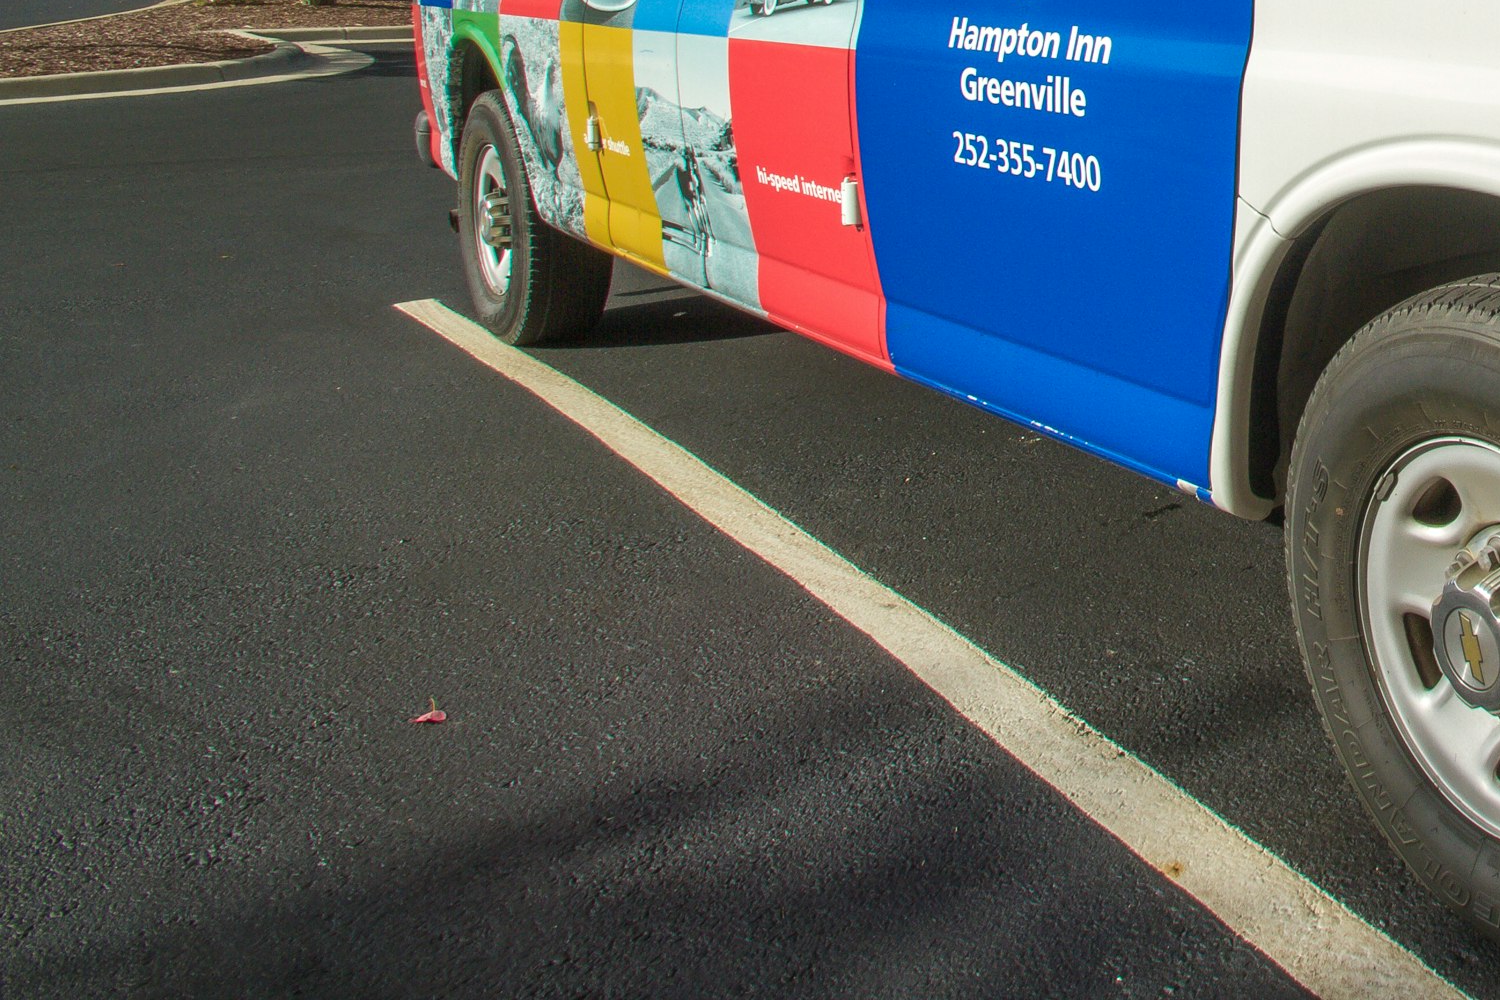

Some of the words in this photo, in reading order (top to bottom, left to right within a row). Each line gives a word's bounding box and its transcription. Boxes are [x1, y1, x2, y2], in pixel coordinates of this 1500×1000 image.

[948, 16, 1061, 63] Hampton
[1066, 25, 1113, 65] Inn
[960, 66, 1087, 118] Greenville
[756, 165, 800, 193] hi-speed
[800, 176, 842, 204] interne
[952, 131, 1101, 192] 252-355-7400
